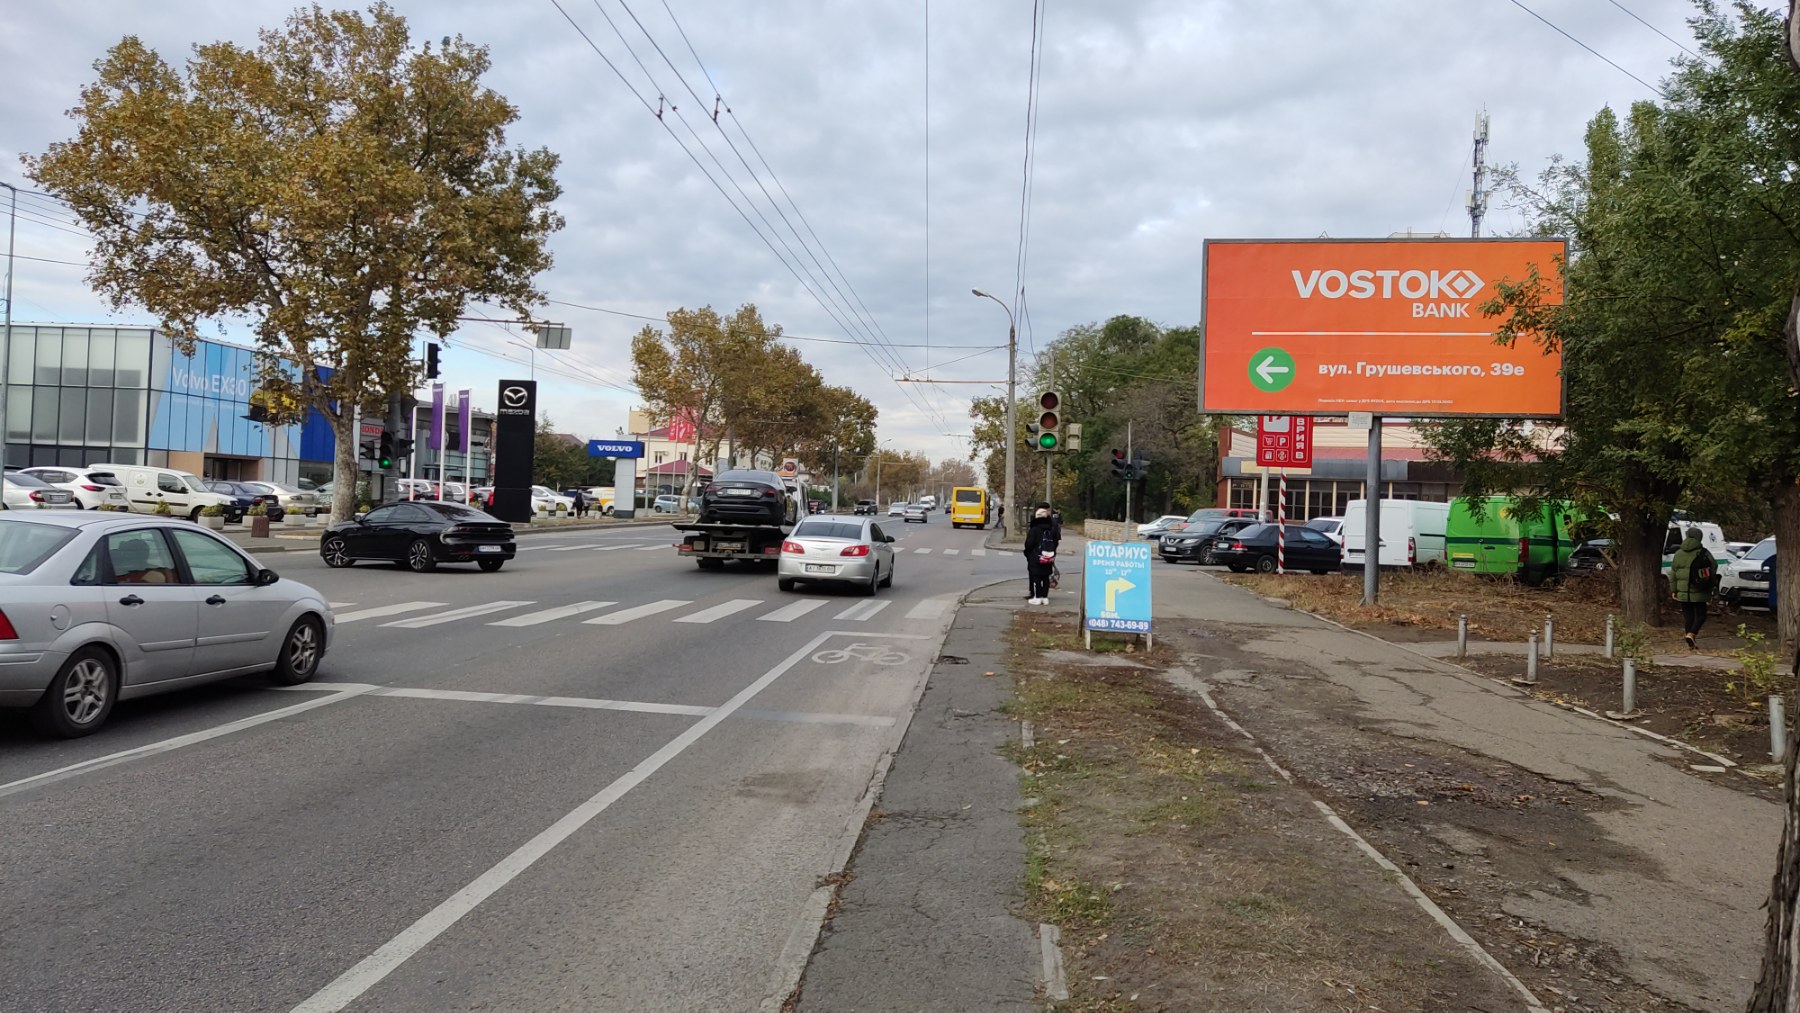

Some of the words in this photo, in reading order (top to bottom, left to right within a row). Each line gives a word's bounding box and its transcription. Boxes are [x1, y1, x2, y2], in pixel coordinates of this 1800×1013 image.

[1292, 270, 1468, 299] VOSTOK
[1412, 303, 1470, 318] BANK
[1318, 364, 1353, 377] вул.
[1356, 361, 1486, 377] Грушевського,
[173, 366, 209, 391] Volvo
[211, 374, 247, 397] EX30
[1295, 417, 1305, 450] ВРИЯ
[597, 444, 633, 452] VOLVO
[1088, 544, 1148, 560] НОТАРИУС
[1093, 559, 1115, 567] ВРЕМЯ
[1116, 561, 1145, 569] РАБОТЫ
[1088, 619, 1109, 628] (048)
